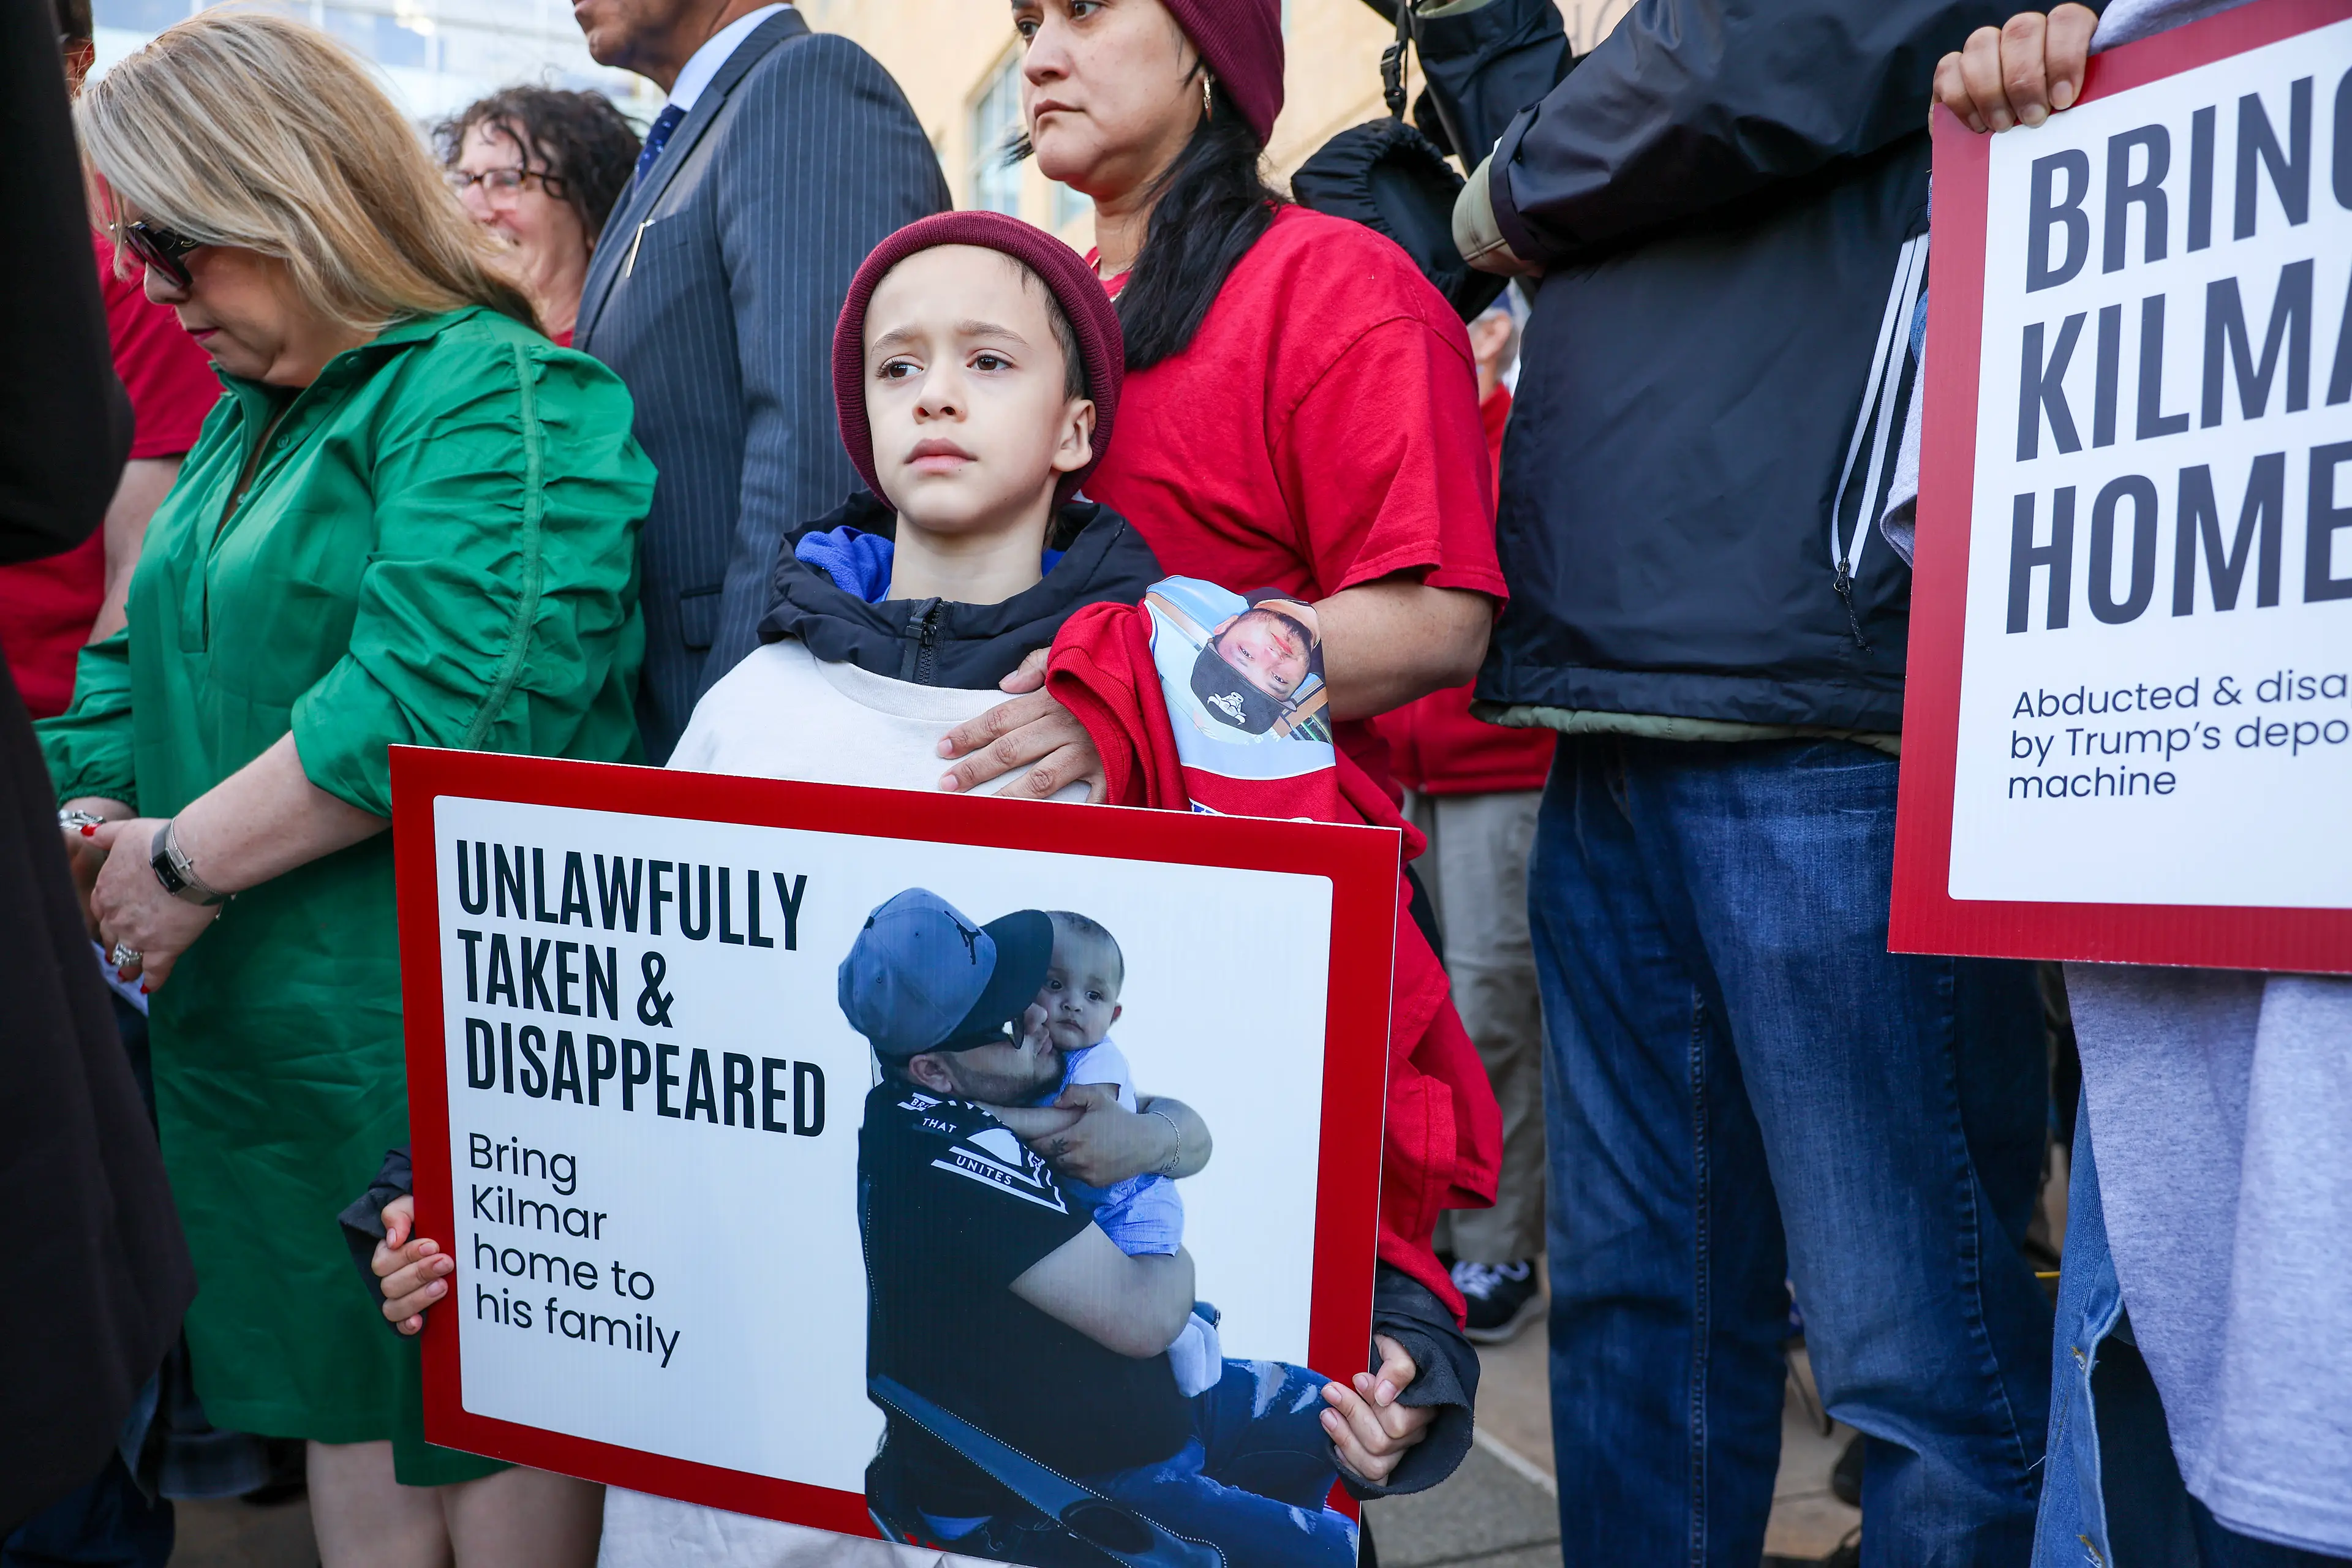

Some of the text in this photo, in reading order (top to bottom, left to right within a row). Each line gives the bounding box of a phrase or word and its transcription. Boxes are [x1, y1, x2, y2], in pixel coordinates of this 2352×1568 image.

[2026, 66, 2352, 293] BRIN
[2006, 440, 2352, 634] HOME
[2013, 669, 2352, 718] Abducted & disa
[2011, 730, 2054, 767] by
[2066, 722, 2220, 761] Trump’s
[2009, 765, 2176, 798] machine
[457, 840, 807, 951] UNLAWFULLY
[458, 929, 674, 1028] TAKEN &
[466, 1017, 824, 1137] DISAPPEARED
[922, 1118, 957, 1133] THAT
[470, 1133, 576, 1196] Bring
[956, 1155, 1012, 1185] UNITES
[472, 1184, 607, 1240] Kilmar
[474, 1233, 654, 1300] home to
[477, 1283, 680, 1368] his family
